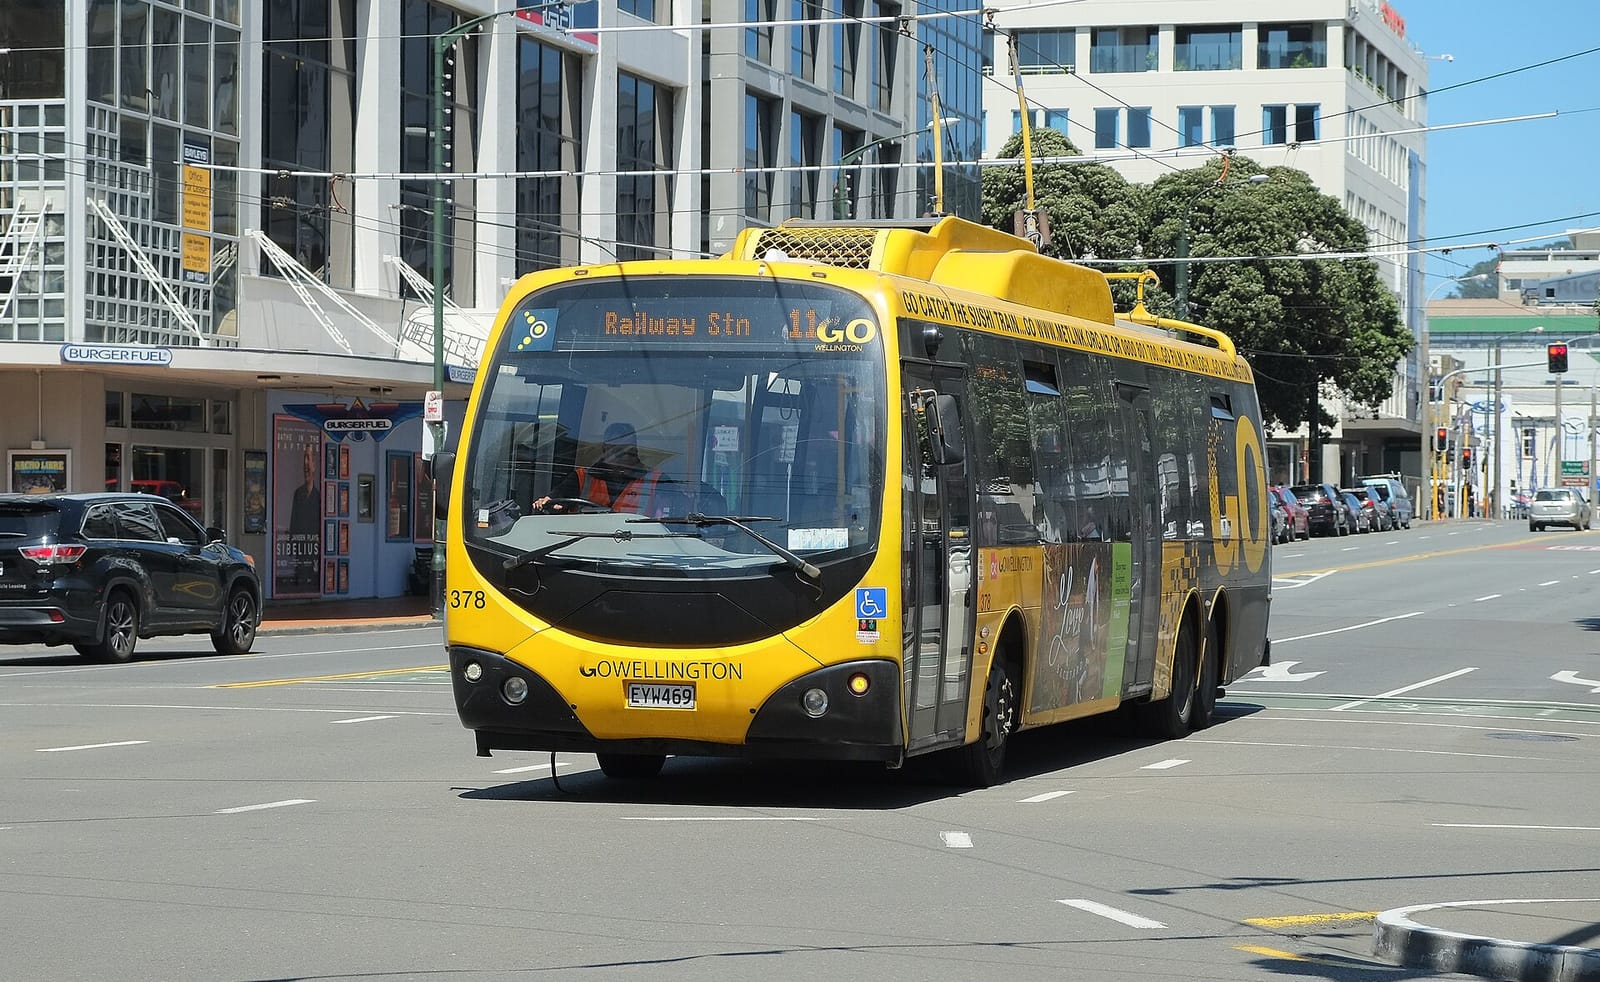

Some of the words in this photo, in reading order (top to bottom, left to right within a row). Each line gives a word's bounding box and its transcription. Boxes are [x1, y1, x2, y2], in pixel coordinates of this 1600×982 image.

[902, 290, 918, 314] GO
[918, 293, 952, 320] CATCH
[950, 301, 969, 323] THE
[968, 304, 995, 328] SUSHI
[605, 311, 697, 337] Railway
[706, 312, 751, 337] Stn
[788, 309, 818, 339] 11
[816, 317, 877, 344] GO
[814, 344, 864, 352] WELLINGTON
[277, 543, 320, 556] SIBELIUS
[450, 590, 486, 609] 378
[981, 593, 991, 611] 378
[630, 687, 693, 705] EYW469
